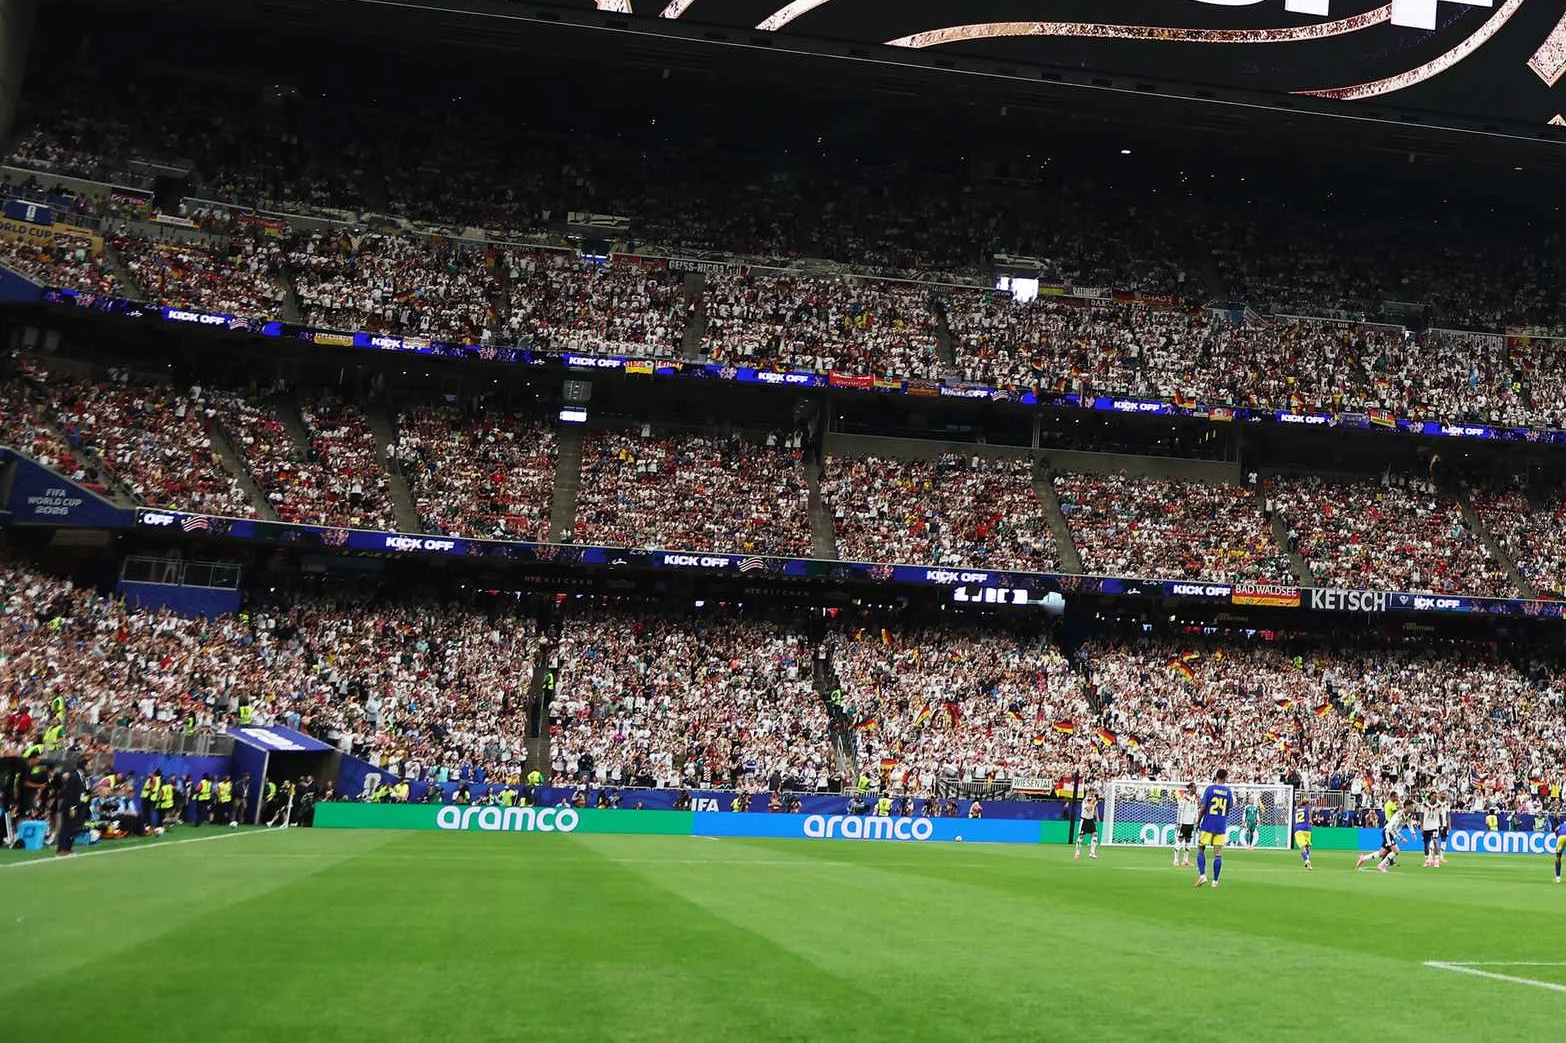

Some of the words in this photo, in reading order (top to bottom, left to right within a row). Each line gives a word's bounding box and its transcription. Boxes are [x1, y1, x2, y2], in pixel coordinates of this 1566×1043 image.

[29, 228, 52, 238] CUP
[168, 310, 198, 322] KICK
[199, 315, 225, 325] OFF
[371, 337, 401, 348] KICK
[568, 357, 596, 367] KICK
[597, 359, 621, 368] OFF
[758, 372, 785, 382] KICK
[786, 374, 808, 383] OFF
[1114, 401, 1139, 411] KICK
[1139, 402, 1161, 412] OFF
[1281, 414, 1304, 423] KICK
[1305, 416, 1326, 424] OFF
[46, 488, 67, 498] FIFA
[27, 496, 62, 506] WORLD
[62, 498, 83, 508] CUP
[34, 506, 69, 516] 2026
[144, 513, 175, 526] OFF
[385, 537, 423, 549] KICK
[424, 539, 455, 551] OFF
[664, 555, 699, 566] KICK
[700, 557, 729, 568] OFF
[926, 570, 960, 582] KICK
[960, 573, 988, 583] OFF
[1173, 585, 1205, 596] KICK
[1206, 586, 1231, 597] OFF
[1235, 584, 1256, 595] BAD
[1256, 585, 1297, 597] WALDSEE
[1311, 588, 1386, 612] KETSCH
[1414, 597, 1435, 609] ICK
[1436, 599, 1460, 608] OFF
[1013, 778, 1051, 789] WIESENTAL
[691, 798, 720, 812] IFA
[1209, 796, 1228, 817] 24
[435, 805, 580, 832] aramco
[802, 814, 934, 841] aramco
[1139, 822, 1260, 848] arco
[1450, 829, 1557, 855] aramco
